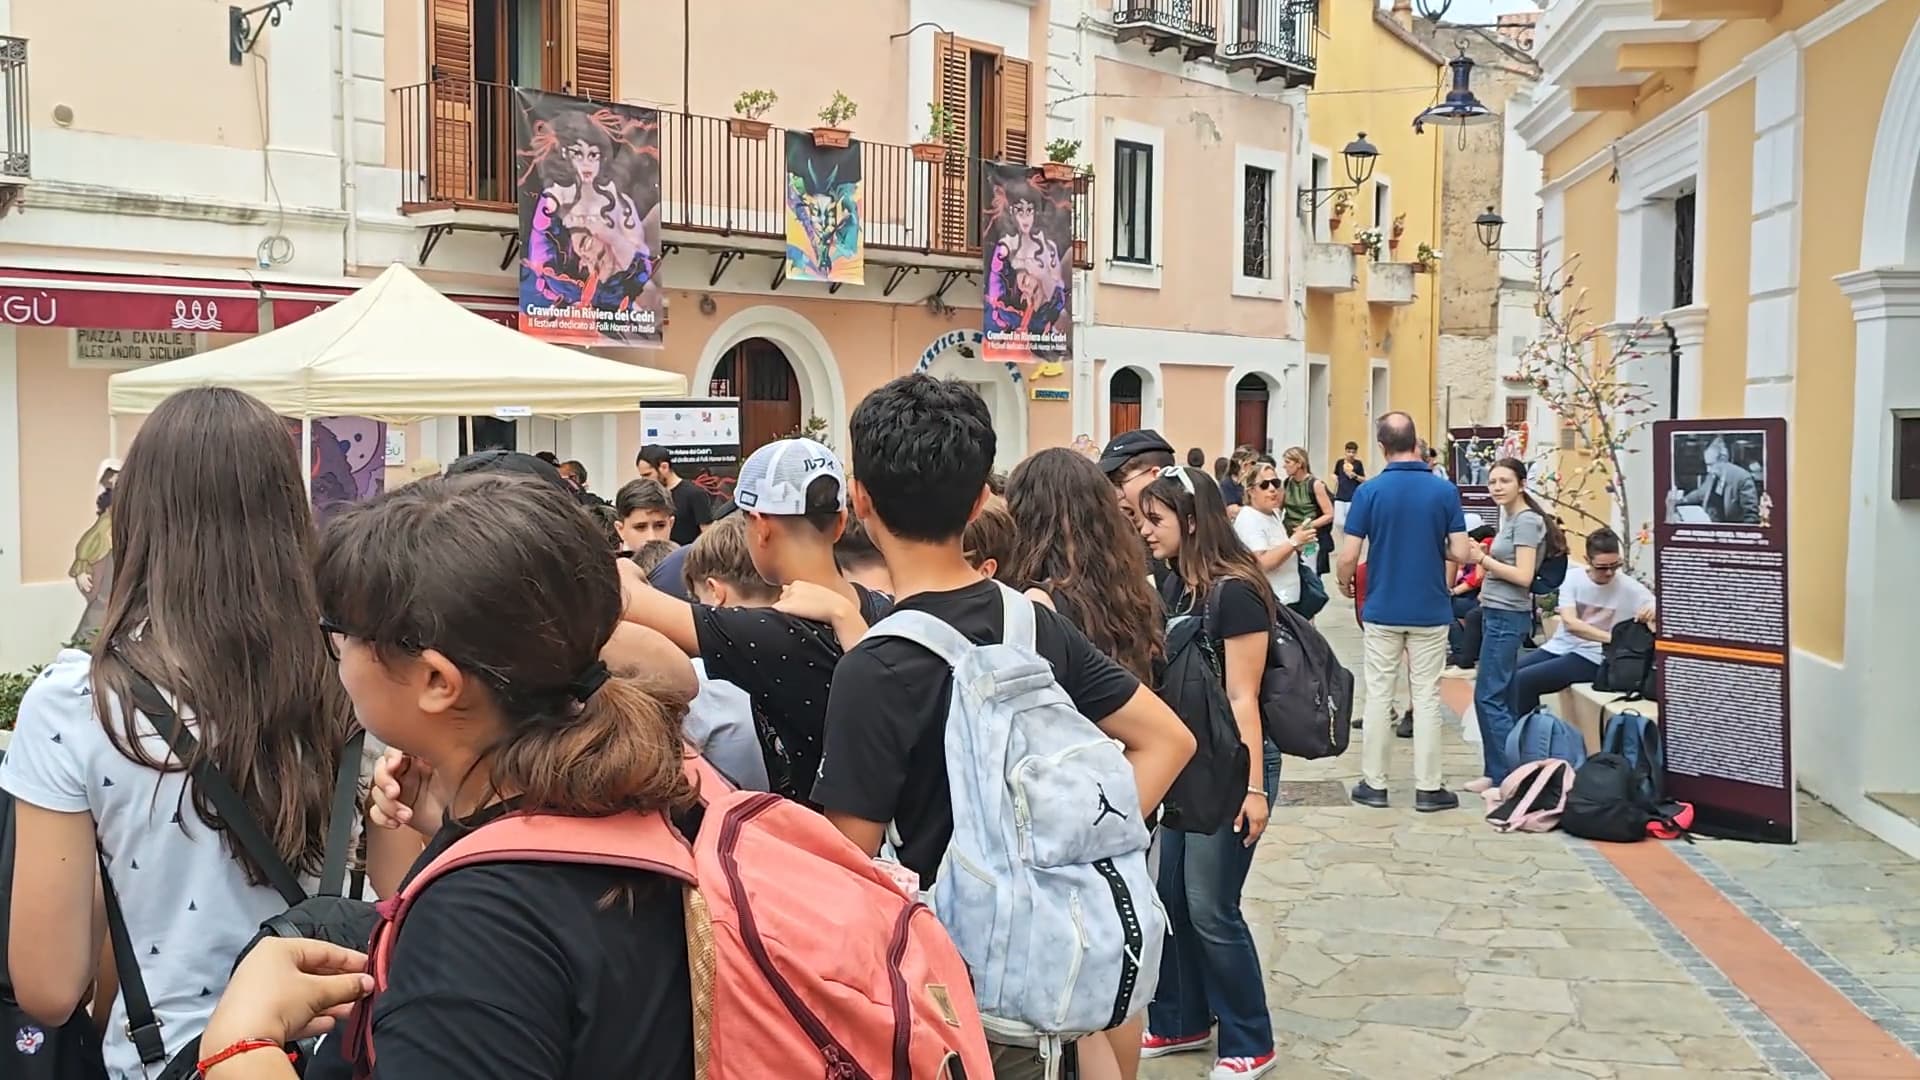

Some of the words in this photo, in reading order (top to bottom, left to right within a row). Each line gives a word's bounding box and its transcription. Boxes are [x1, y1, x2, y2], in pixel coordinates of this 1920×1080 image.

[0, 291, 56, 324] GÙ
[527, 303, 570, 318] Crawford
[571, 307, 580, 317] in
[582, 307, 613, 320] Riviera
[615, 310, 629, 321] dei
[630, 310, 655, 323] Cedri
[534, 318, 558, 328] festival
[559, 319, 589, 330] dedicato
[596, 322, 610, 332] Folk
[610, 323, 630, 333] Horror
[638, 324, 655, 334] Italia
[77, 329, 122, 343] PIAZZA
[803, 457, 834, 472] ルフィ
